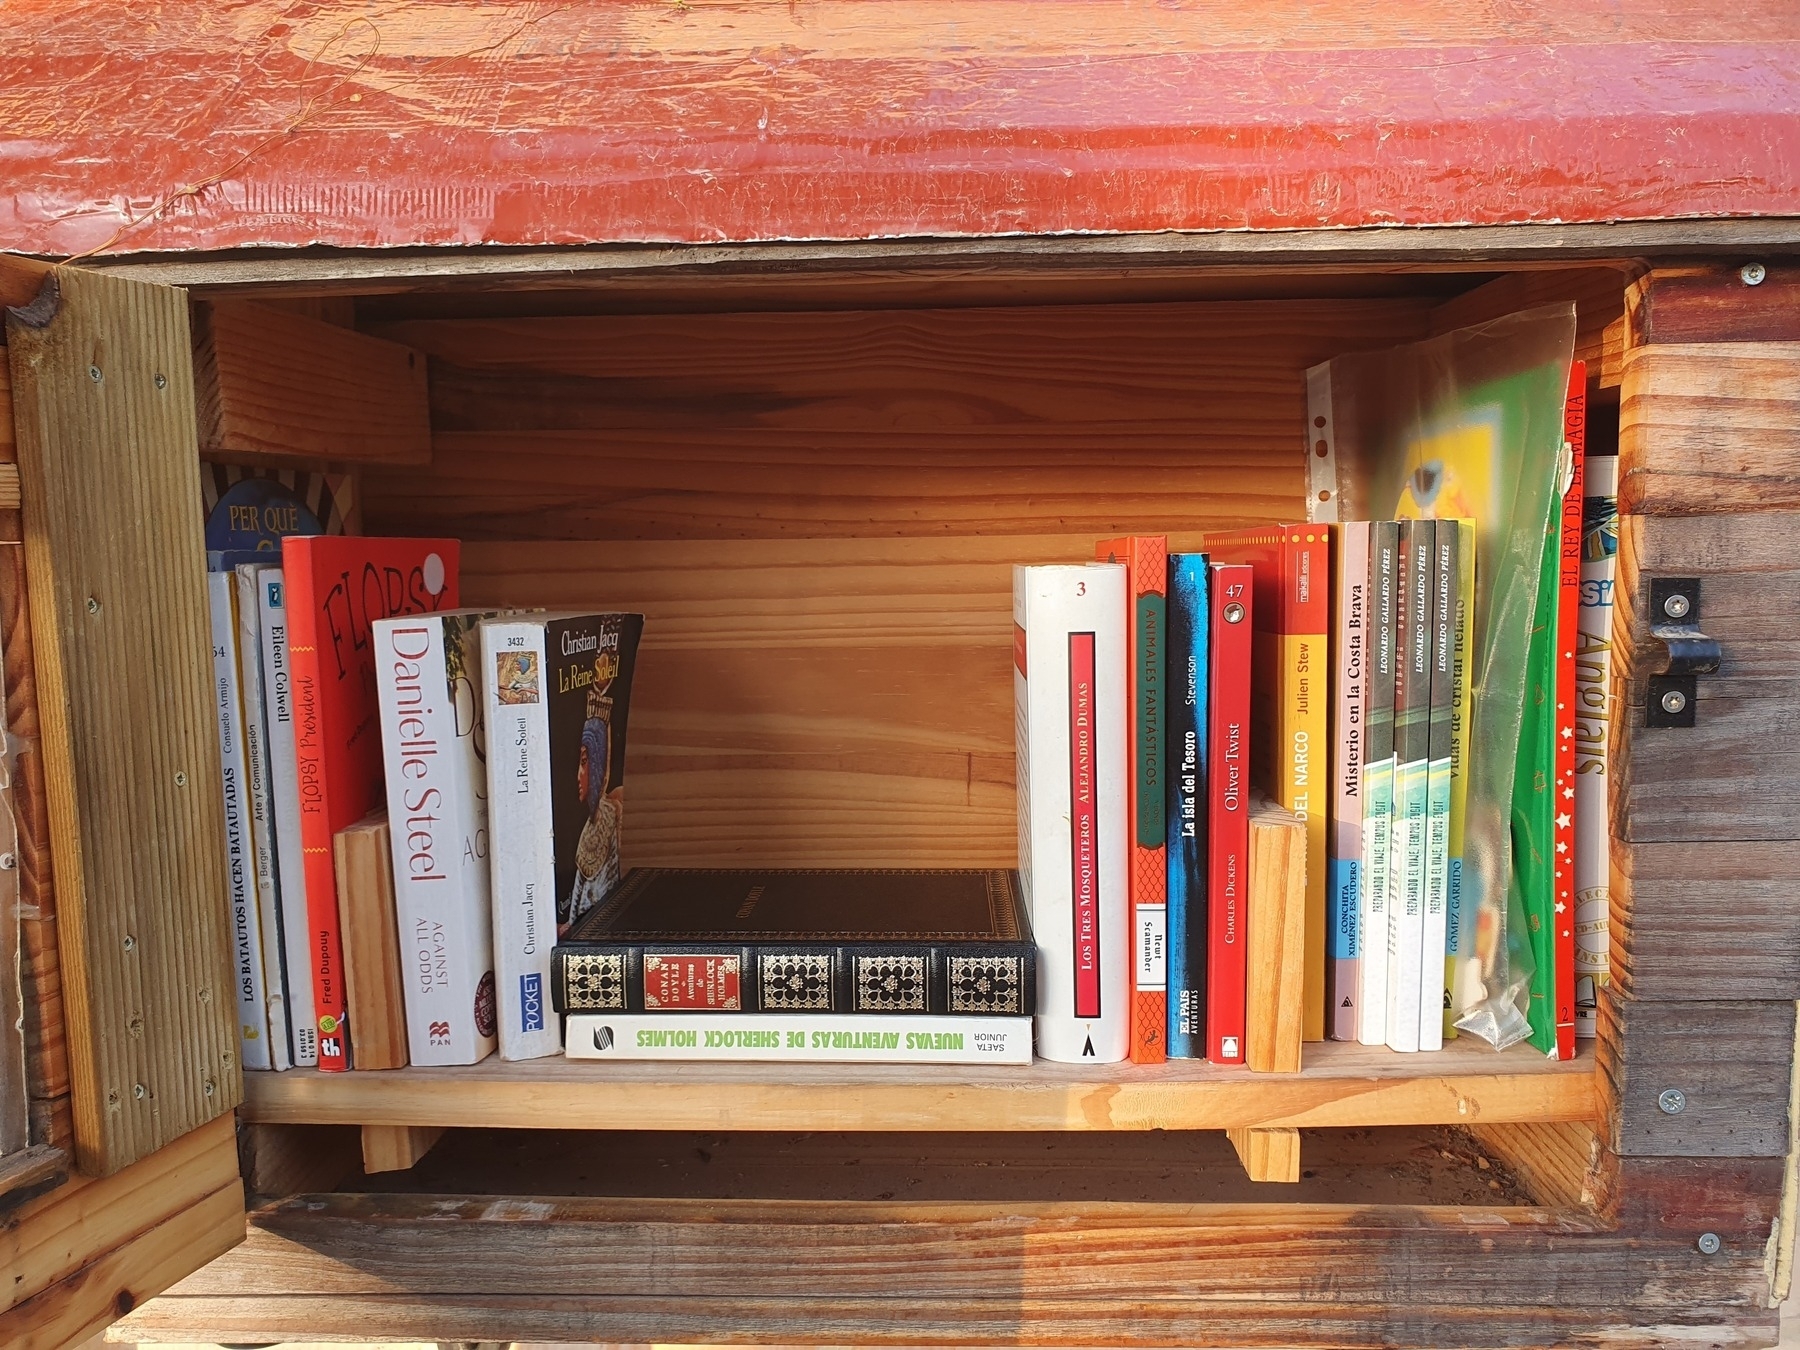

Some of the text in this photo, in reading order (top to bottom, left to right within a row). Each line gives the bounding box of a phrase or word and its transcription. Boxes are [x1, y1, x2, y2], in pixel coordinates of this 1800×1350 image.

[1566, 395, 1583, 457] MAGIA
[229, 503, 299, 535] PER QUÈ
[1564, 493, 1581, 517] DE
[1563, 525, 1580, 559] REY
[1076, 581, 1086, 597] 3
[1189, 571, 1194, 581] 1
[1225, 584, 1244, 598] 47
[1562, 565, 1578, 588] EL
[1380, 548, 1391, 674] LEONARDO GALLARDO PÉREZ
[1416, 545, 1426, 673] LEONARDO GALLARDO PÉREZ
[1439, 544, 1450, 672] LEONARDO GALLARDO PÉREZ
[507, 637, 525, 647] 3432
[561, 624, 619, 656] Christian Jacq
[1145, 609, 1156, 682] ANIMALES
[272, 625, 290, 722] Eileen Colwell
[559, 655, 620, 694] La Reine Soleil
[1185, 655, 1196, 705] Stevenson
[1297, 643, 1309, 715] Julien Stew
[1345, 584, 1362, 797] Misterio en la Costa Brava
[218, 677, 232, 754] Consuelo Armijo
[1452, 713, 1461, 732] de
[1575, 630, 1613, 776] Anglais
[391, 628, 446, 881] Danielle Steel
[515, 717, 529, 794] La Reine Soleil
[1145, 689, 1159, 785] FANTÁSTICOS
[249, 724, 264, 821] Arte y Comunicación
[300, 757, 323, 813] FLOPSY
[1181, 731, 1196, 837] La isla del Tesoro
[1224, 723, 1240, 811] Oliver Twist
[1294, 731, 1309, 821] DEL NARCO
[1077, 682, 1092, 970] LOS TRES MOSQUETEROS ALEJANDRO DUMAS
[1374, 800, 1386, 818] FUGIT
[1409, 802, 1421, 820] FUGIT
[1432, 800, 1444, 818] FUGIT
[1374, 821, 1386, 845] TEMPUS
[1408, 822, 1420, 846] TEMPUS
[1431, 821, 1443, 845] TEMPUS
[260, 847, 269, 877] Berger
[223, 767, 254, 1003] LOS BATAUTOS HACEN BATAUTADAS
[1224, 854, 1236, 944] CHARLES DICKENS
[1372, 877, 1384, 913] PREPARANDO
[1407, 879, 1419, 916] PREPARANDO
[1430, 877, 1442, 914] PREPARANDO
[522, 883, 536, 955] Christian Jacq
[1341, 884, 1349, 934] CONCHITA
[1348, 861, 1357, 956] XIMÉNEZ ESCUDERO
[1448, 861, 1462, 952] GÓMEZ GARRIDO
[320, 930, 332, 975] Dupouy
[416, 917, 434, 994] ALL ODDS
[433, 922, 449, 987] AGAINST
[1144, 921, 1153, 972] Scamander
[1154, 934, 1163, 959] Newt
[321, 979, 332, 1005] Fred
[661, 963, 669, 1002] CONAN
[672, 963, 680, 1002] DOYLE
[687, 963, 695, 1000] Aventuras
[697, 978, 704, 988] de
[707, 958, 715, 1005] SHERLOCK
[717, 964, 726, 1001] HOLMES
[524, 973, 540, 1032] POCKET
[1562, 1006, 1569, 1021] 2
[636, 1029, 964, 1050] NUEVAS AVENTURAS DE SHERLOCK HOLMES
[974, 1033, 1008, 1041] JUNIOR
[1180, 1017, 1189, 1034] EL
[977, 1043, 1005, 1052] SAETA
